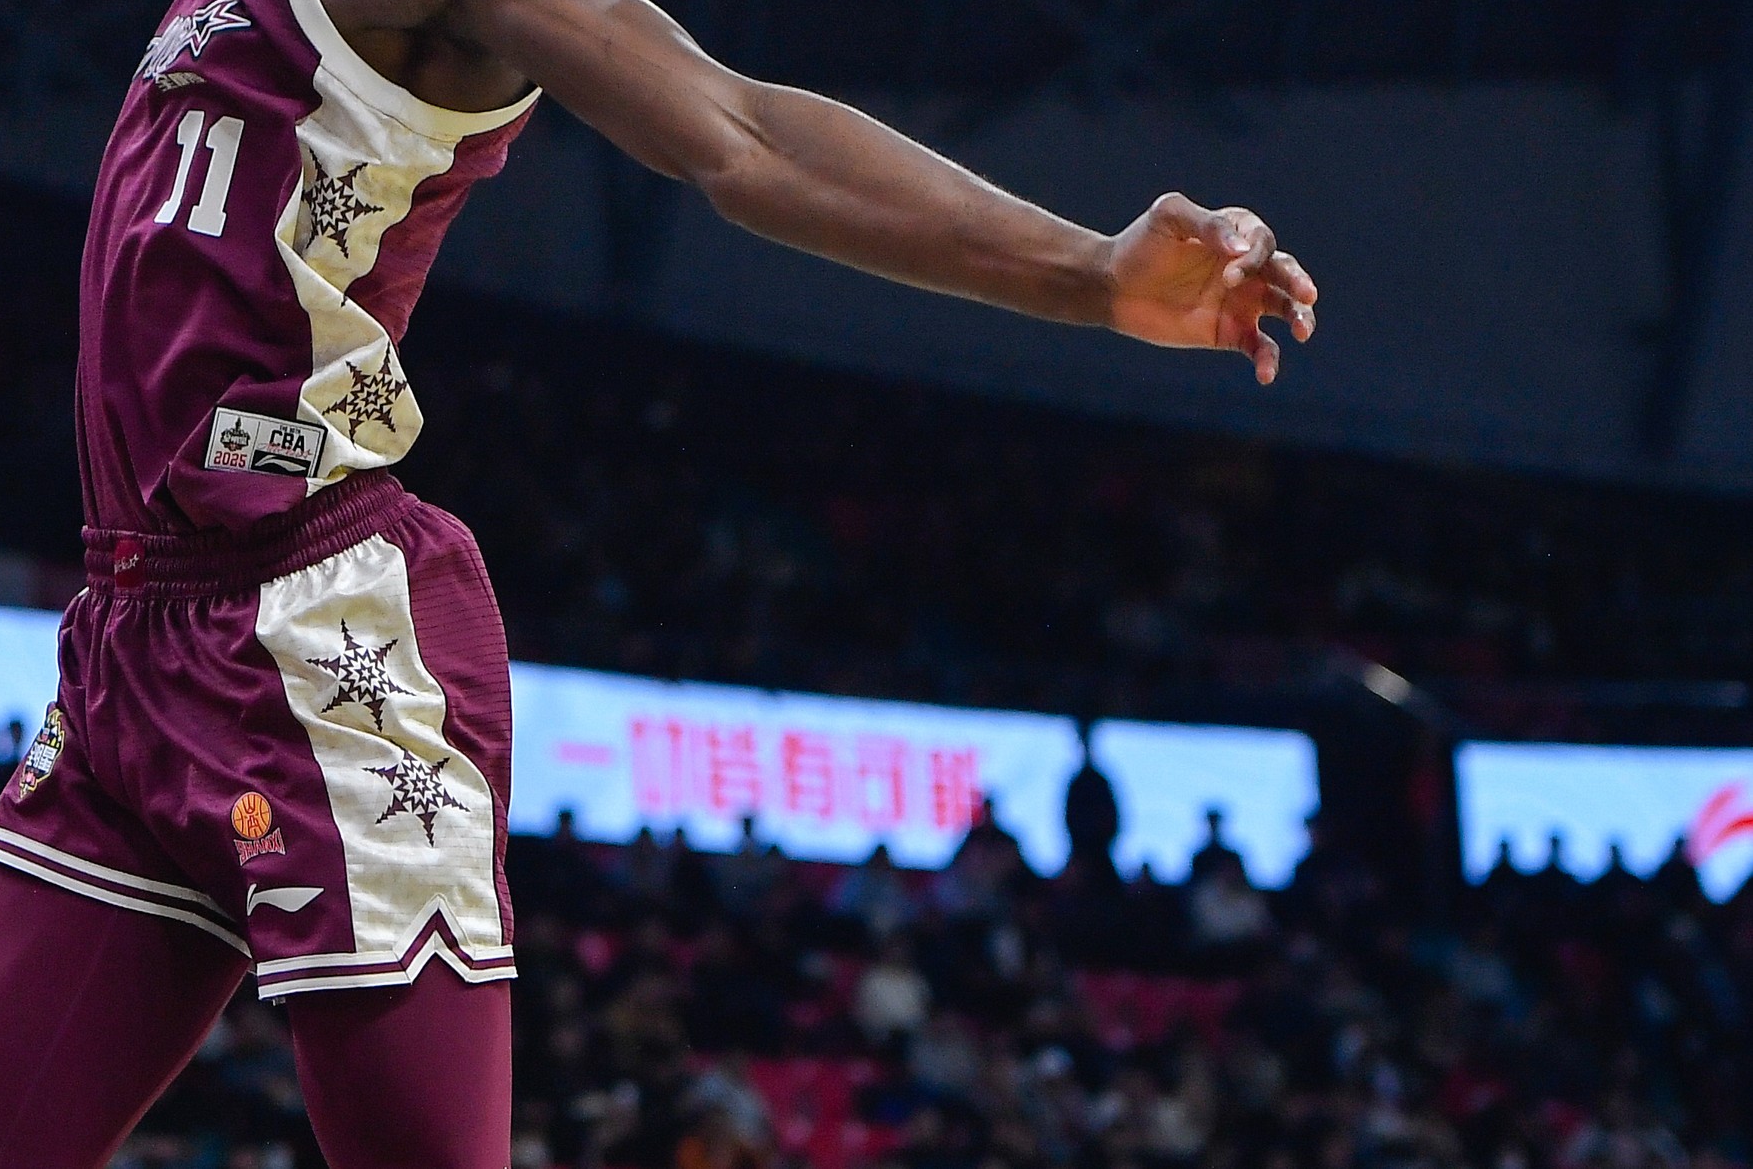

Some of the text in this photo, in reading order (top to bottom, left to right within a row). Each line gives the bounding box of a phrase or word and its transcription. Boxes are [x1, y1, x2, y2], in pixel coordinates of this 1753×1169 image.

[153, 110, 244, 237] 11
[270, 430, 306, 452] CBA
[214, 451, 248, 468] 2025
[234, 828, 286, 866] SHANXI
